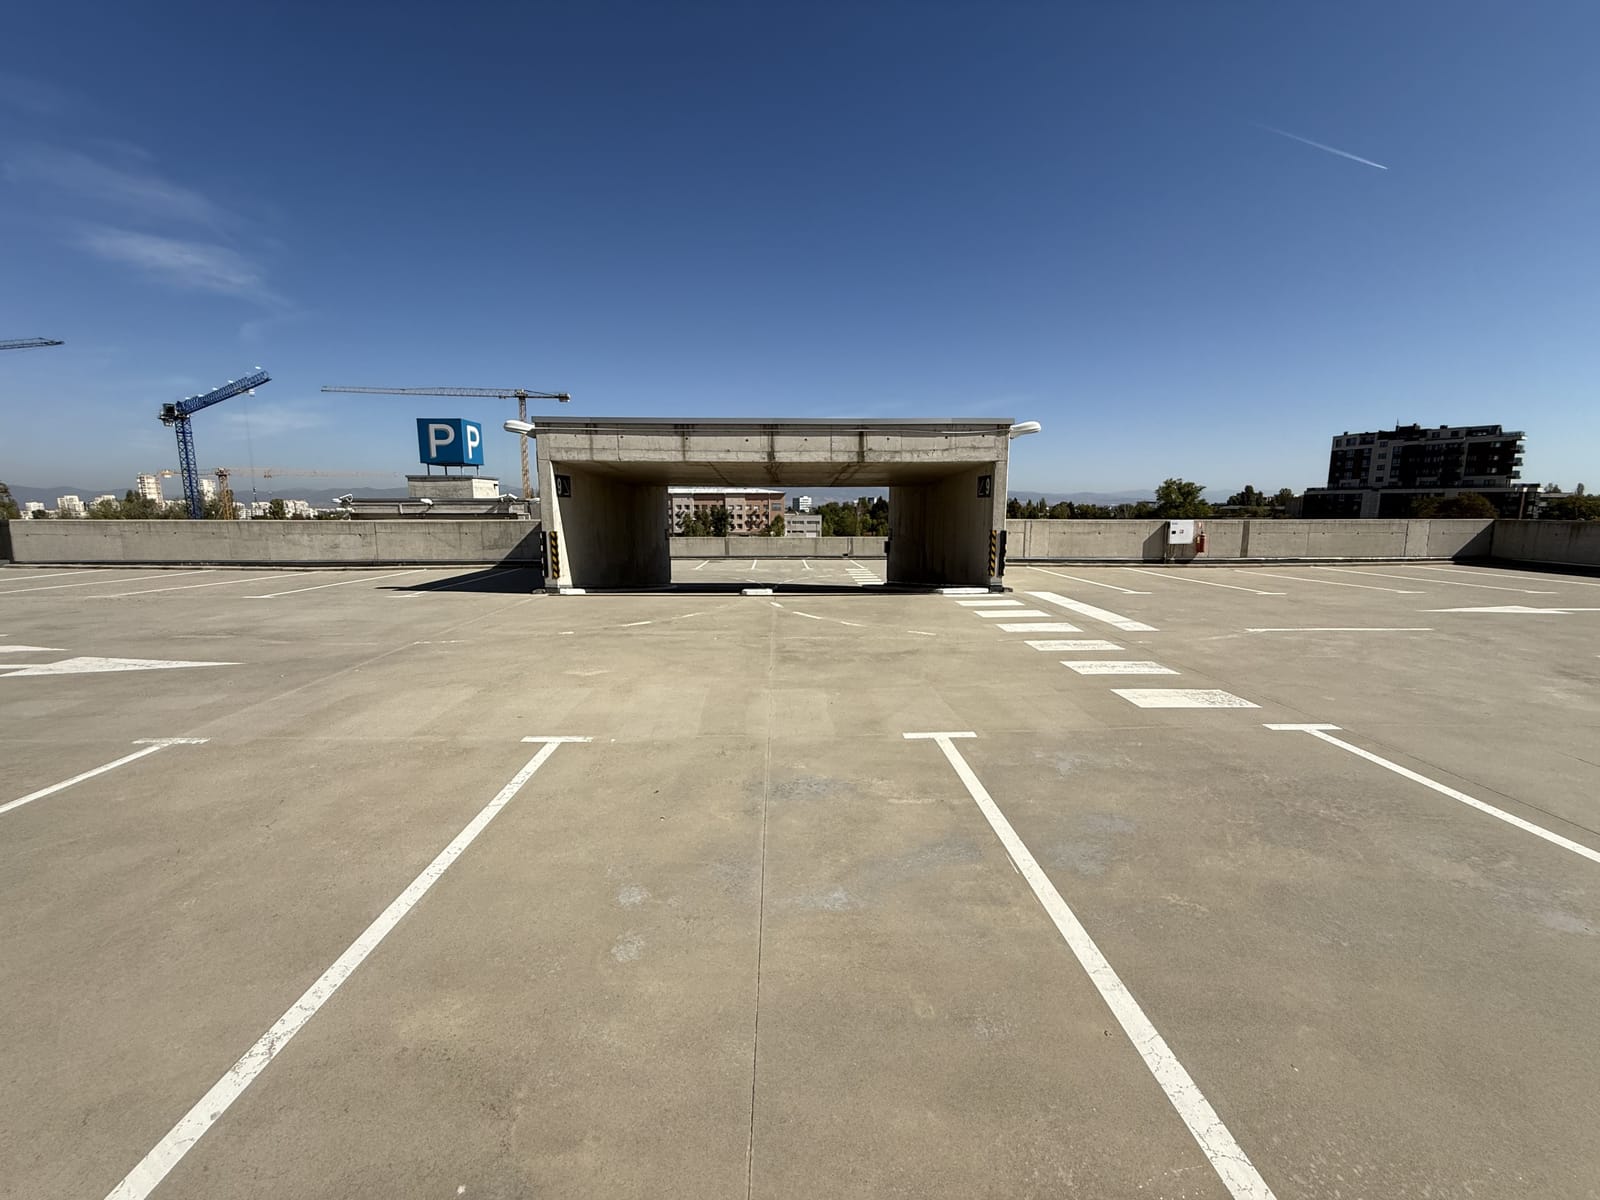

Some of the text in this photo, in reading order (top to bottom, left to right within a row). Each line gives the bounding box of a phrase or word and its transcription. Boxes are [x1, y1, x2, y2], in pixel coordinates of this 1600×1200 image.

[428, 424, 454, 458] P
[466, 425, 480, 459] P
[557, 477, 562, 495] 9
[985, 478, 990, 495] 9
